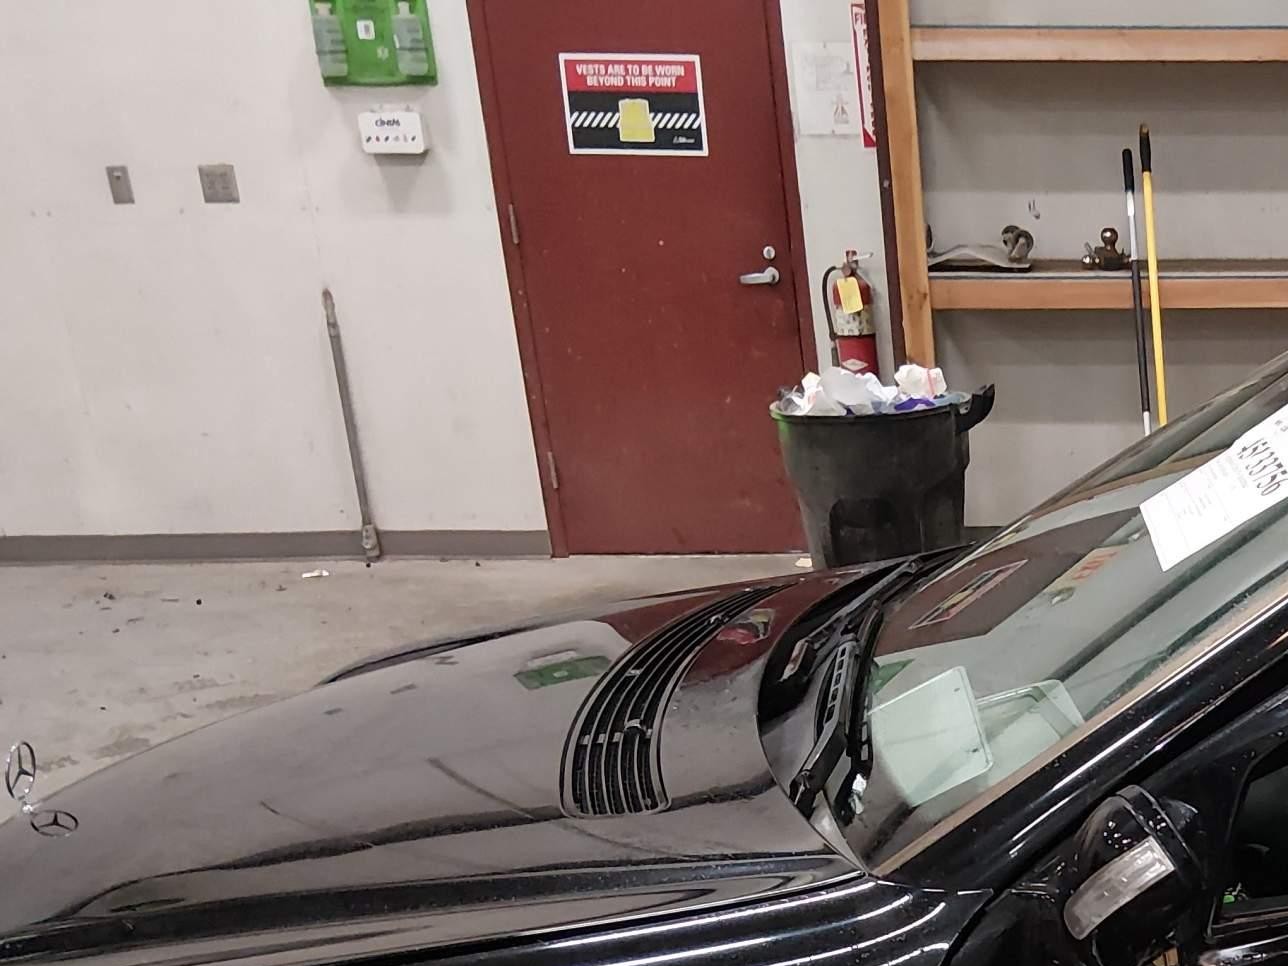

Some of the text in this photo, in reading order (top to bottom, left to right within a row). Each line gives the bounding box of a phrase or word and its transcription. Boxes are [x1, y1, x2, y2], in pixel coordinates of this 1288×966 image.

[576, 64, 685, 76] VESTS ARE TO BE WORN
[586, 75, 676, 87] BEYOND THIS POINT
